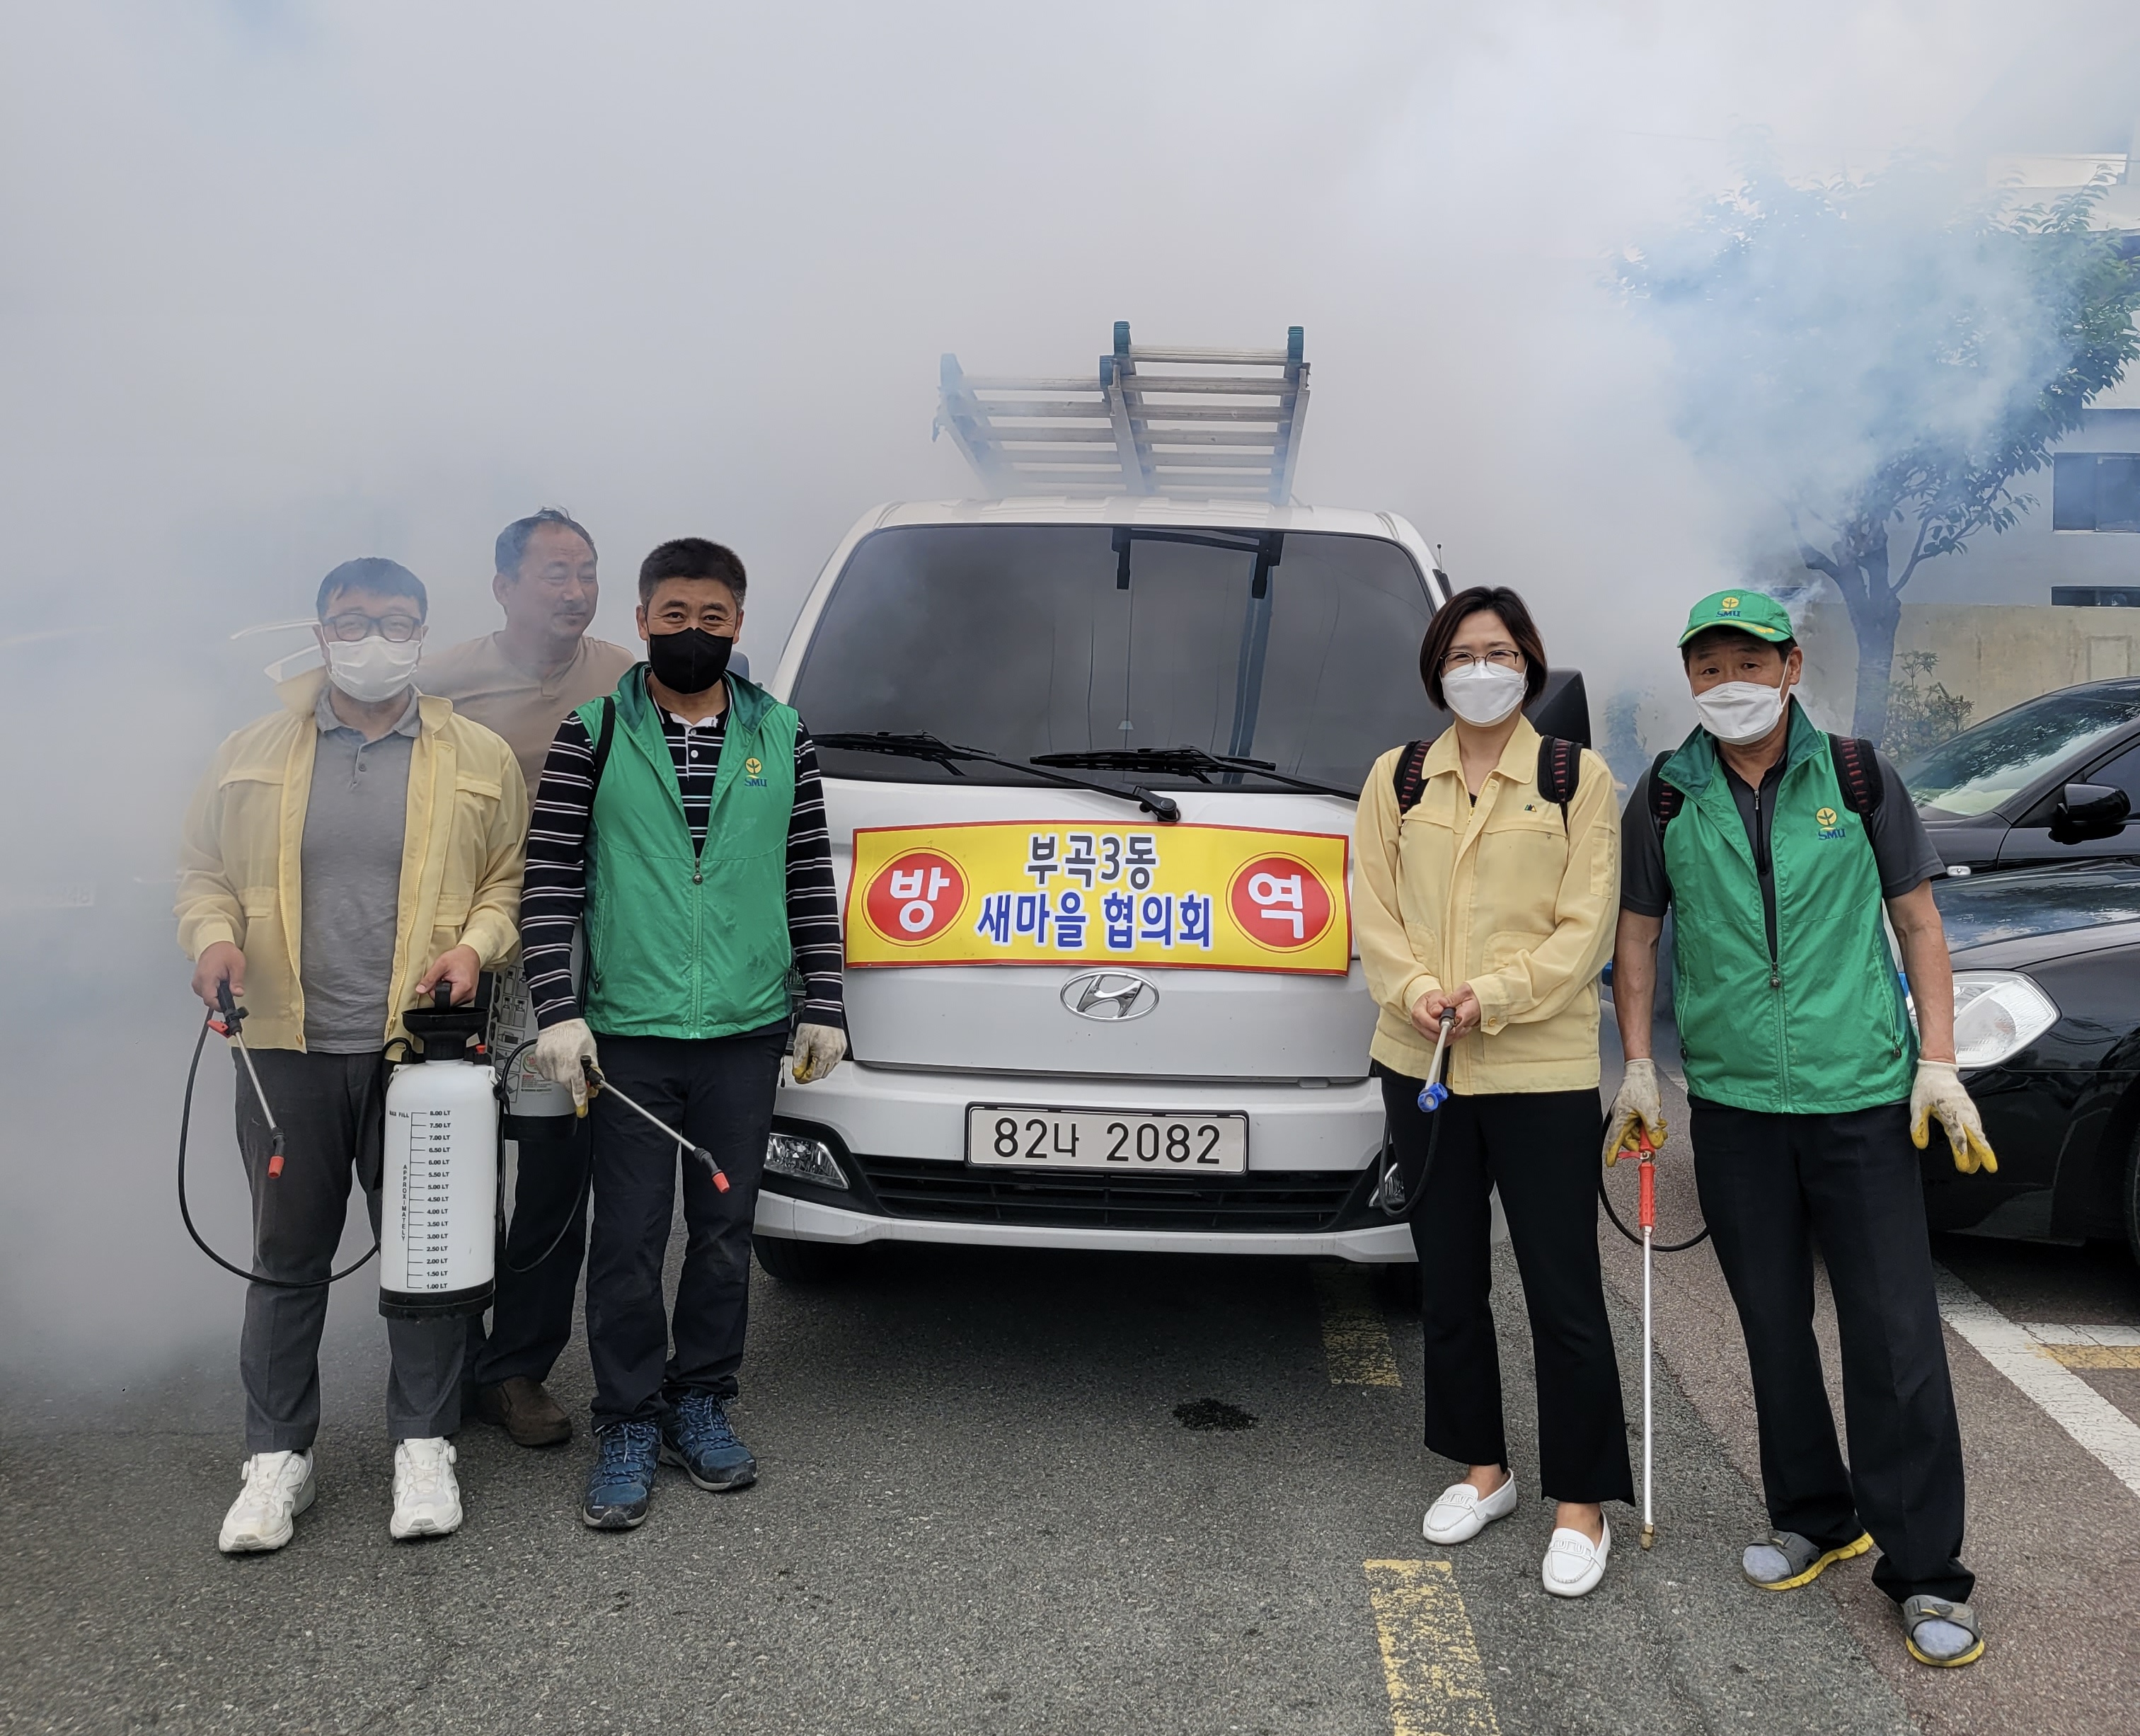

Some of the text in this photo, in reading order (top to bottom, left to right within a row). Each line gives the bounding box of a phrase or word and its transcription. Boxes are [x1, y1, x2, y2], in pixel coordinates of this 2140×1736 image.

[744, 778, 767, 787] SMU
[1026, 834, 1157, 890] 부곡3동
[1818, 828, 1846, 840] SMU
[889, 866, 951, 933] 방
[977, 890, 1211, 949] 새마을 협의회
[1247, 872, 1305, 939] 역
[994, 1116, 1221, 1165] 82나 2082
